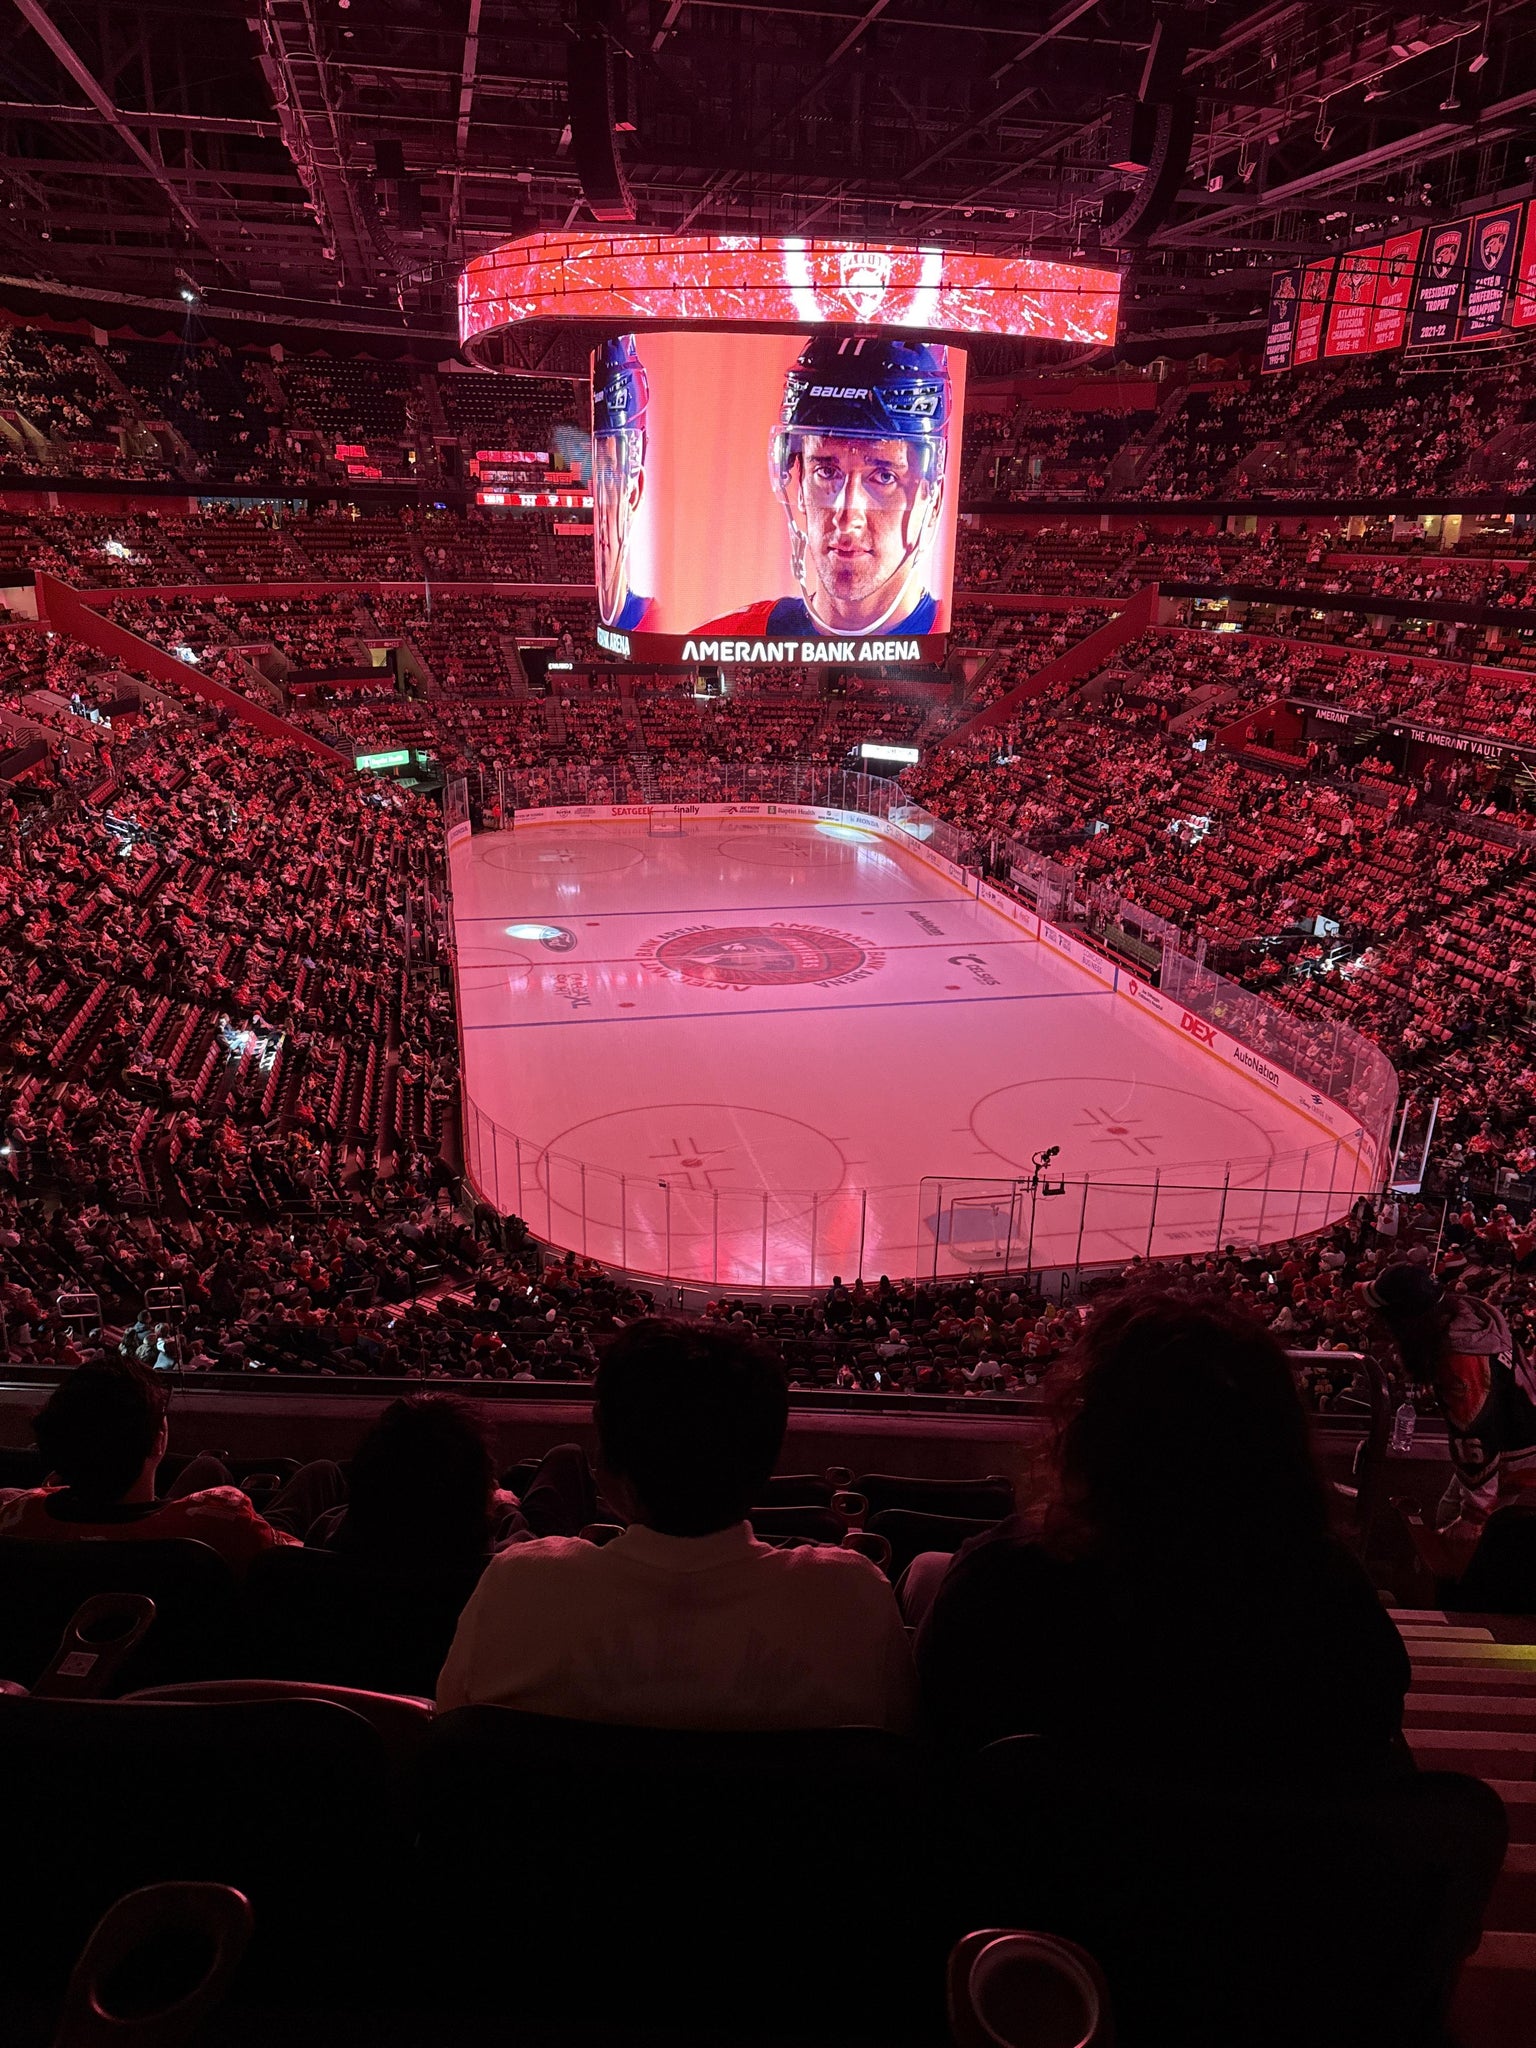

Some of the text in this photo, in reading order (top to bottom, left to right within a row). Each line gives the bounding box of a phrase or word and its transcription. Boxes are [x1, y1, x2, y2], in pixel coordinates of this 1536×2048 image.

[1468, 290, 1503, 305] CONFERENCE
[1425, 298, 1449, 312] TROPHY
[1468, 300, 1501, 317] CHAMPIONS
[1338, 307, 1366, 320] ATLANTIC
[1336, 318, 1363, 330] DIVISION
[1331, 328, 1365, 340] CHAMPIONS
[1420, 325, 1446, 338] 2021-22
[681, 641, 920, 662] AMERANT BANK ARENA
[1315, 709, 1350, 724] AMERANT
[1411, 729, 1503, 758] THE AMERANT VAULT
[611, 806, 653, 817] SEATGEEK
[674, 805, 700, 816] finally
[777, 807, 816, 816] Baptist Health
[856, 817, 879, 829] HONDA
[657, 924, 715, 941] ARENA
[1180, 1012, 1218, 1049] DEX
[1233, 1047, 1280, 1085] AutoNation
